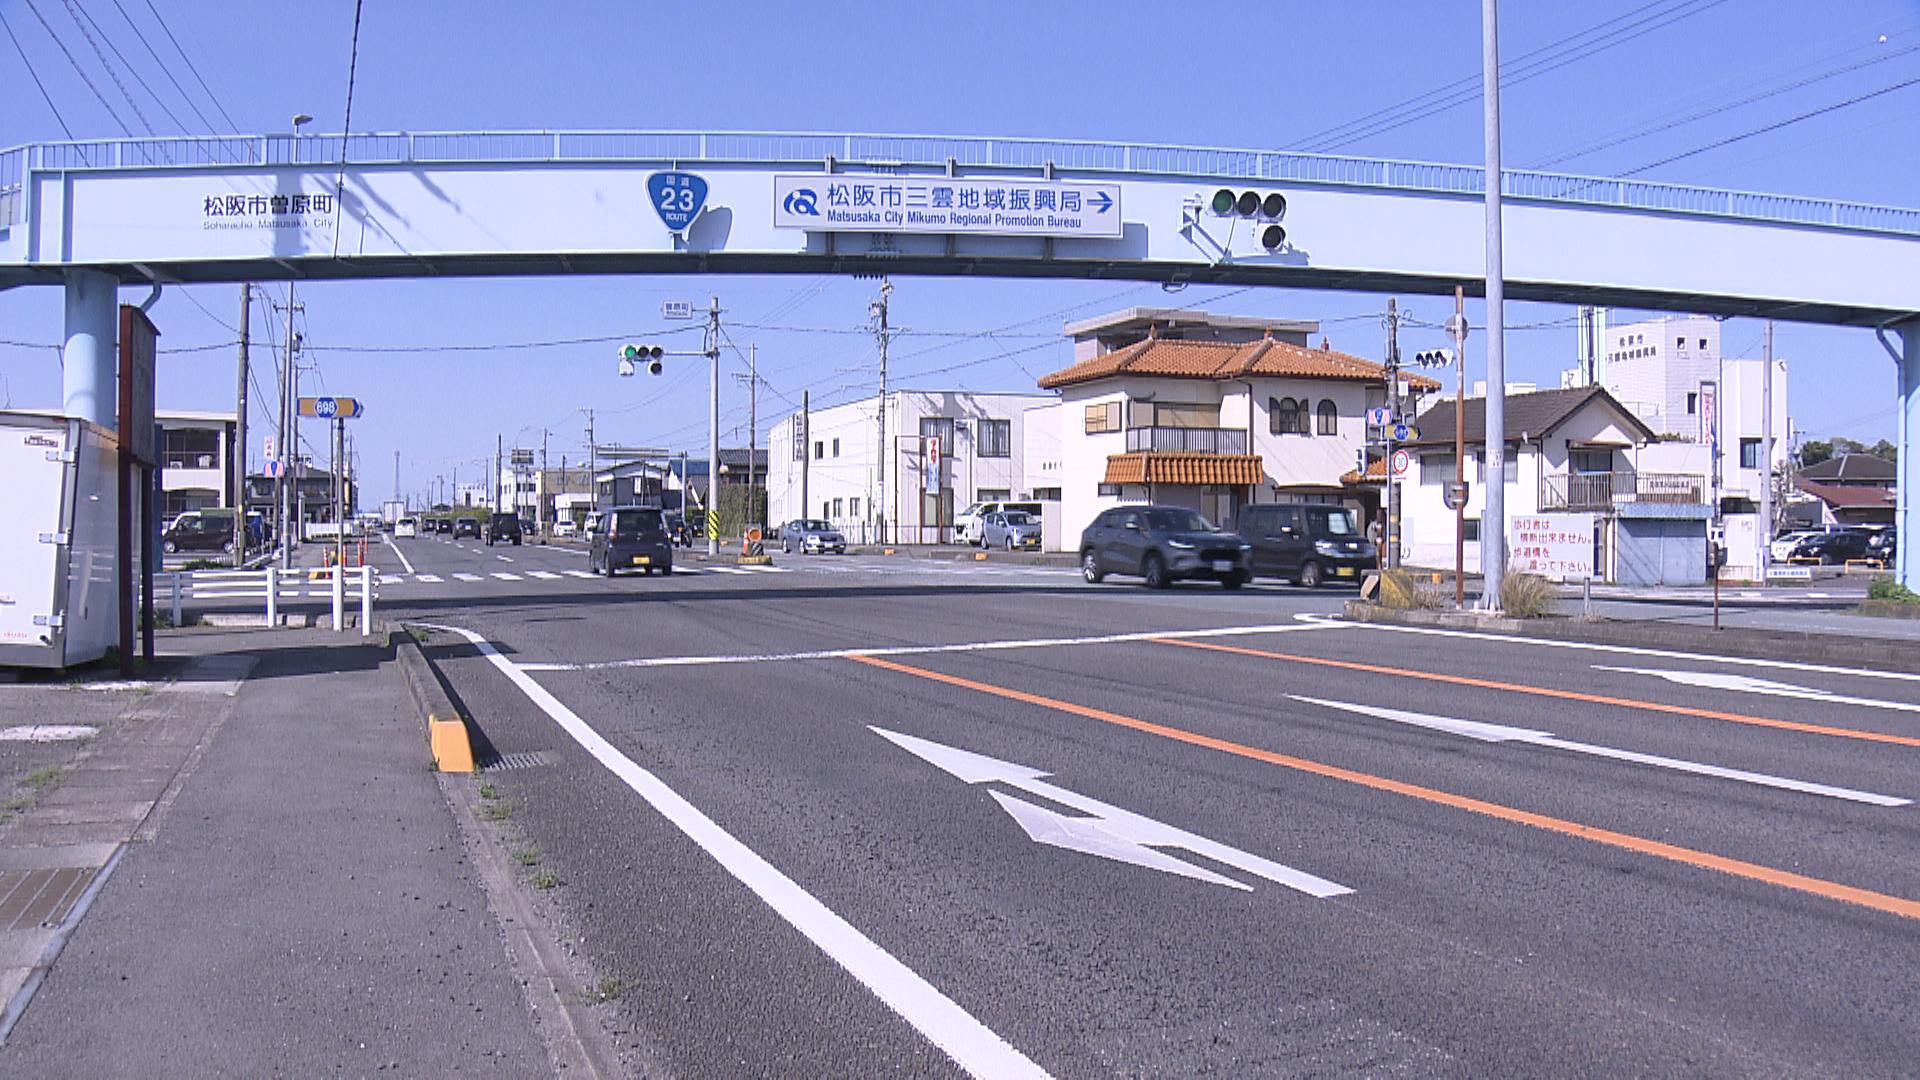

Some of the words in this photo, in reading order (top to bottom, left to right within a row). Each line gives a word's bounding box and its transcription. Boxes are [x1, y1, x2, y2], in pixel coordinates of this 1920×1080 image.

[203, 195, 334, 216] 松阪市曽原町
[661, 187, 694, 211] 23
[827, 183, 1082, 212] 松阪市三雲地域振興局
[313, 218, 334, 229] City
[665, 213, 688, 222] ROUTE
[827, 209, 880, 223] Matsusaka
[884, 210, 904, 225] City
[907, 211, 946, 224] Mikumo
[950, 212, 992, 226] Regional
[995, 213, 1044, 227] Promotion
[1048, 215, 1082, 228] Bureau
[316, 401, 336, 415] 698
